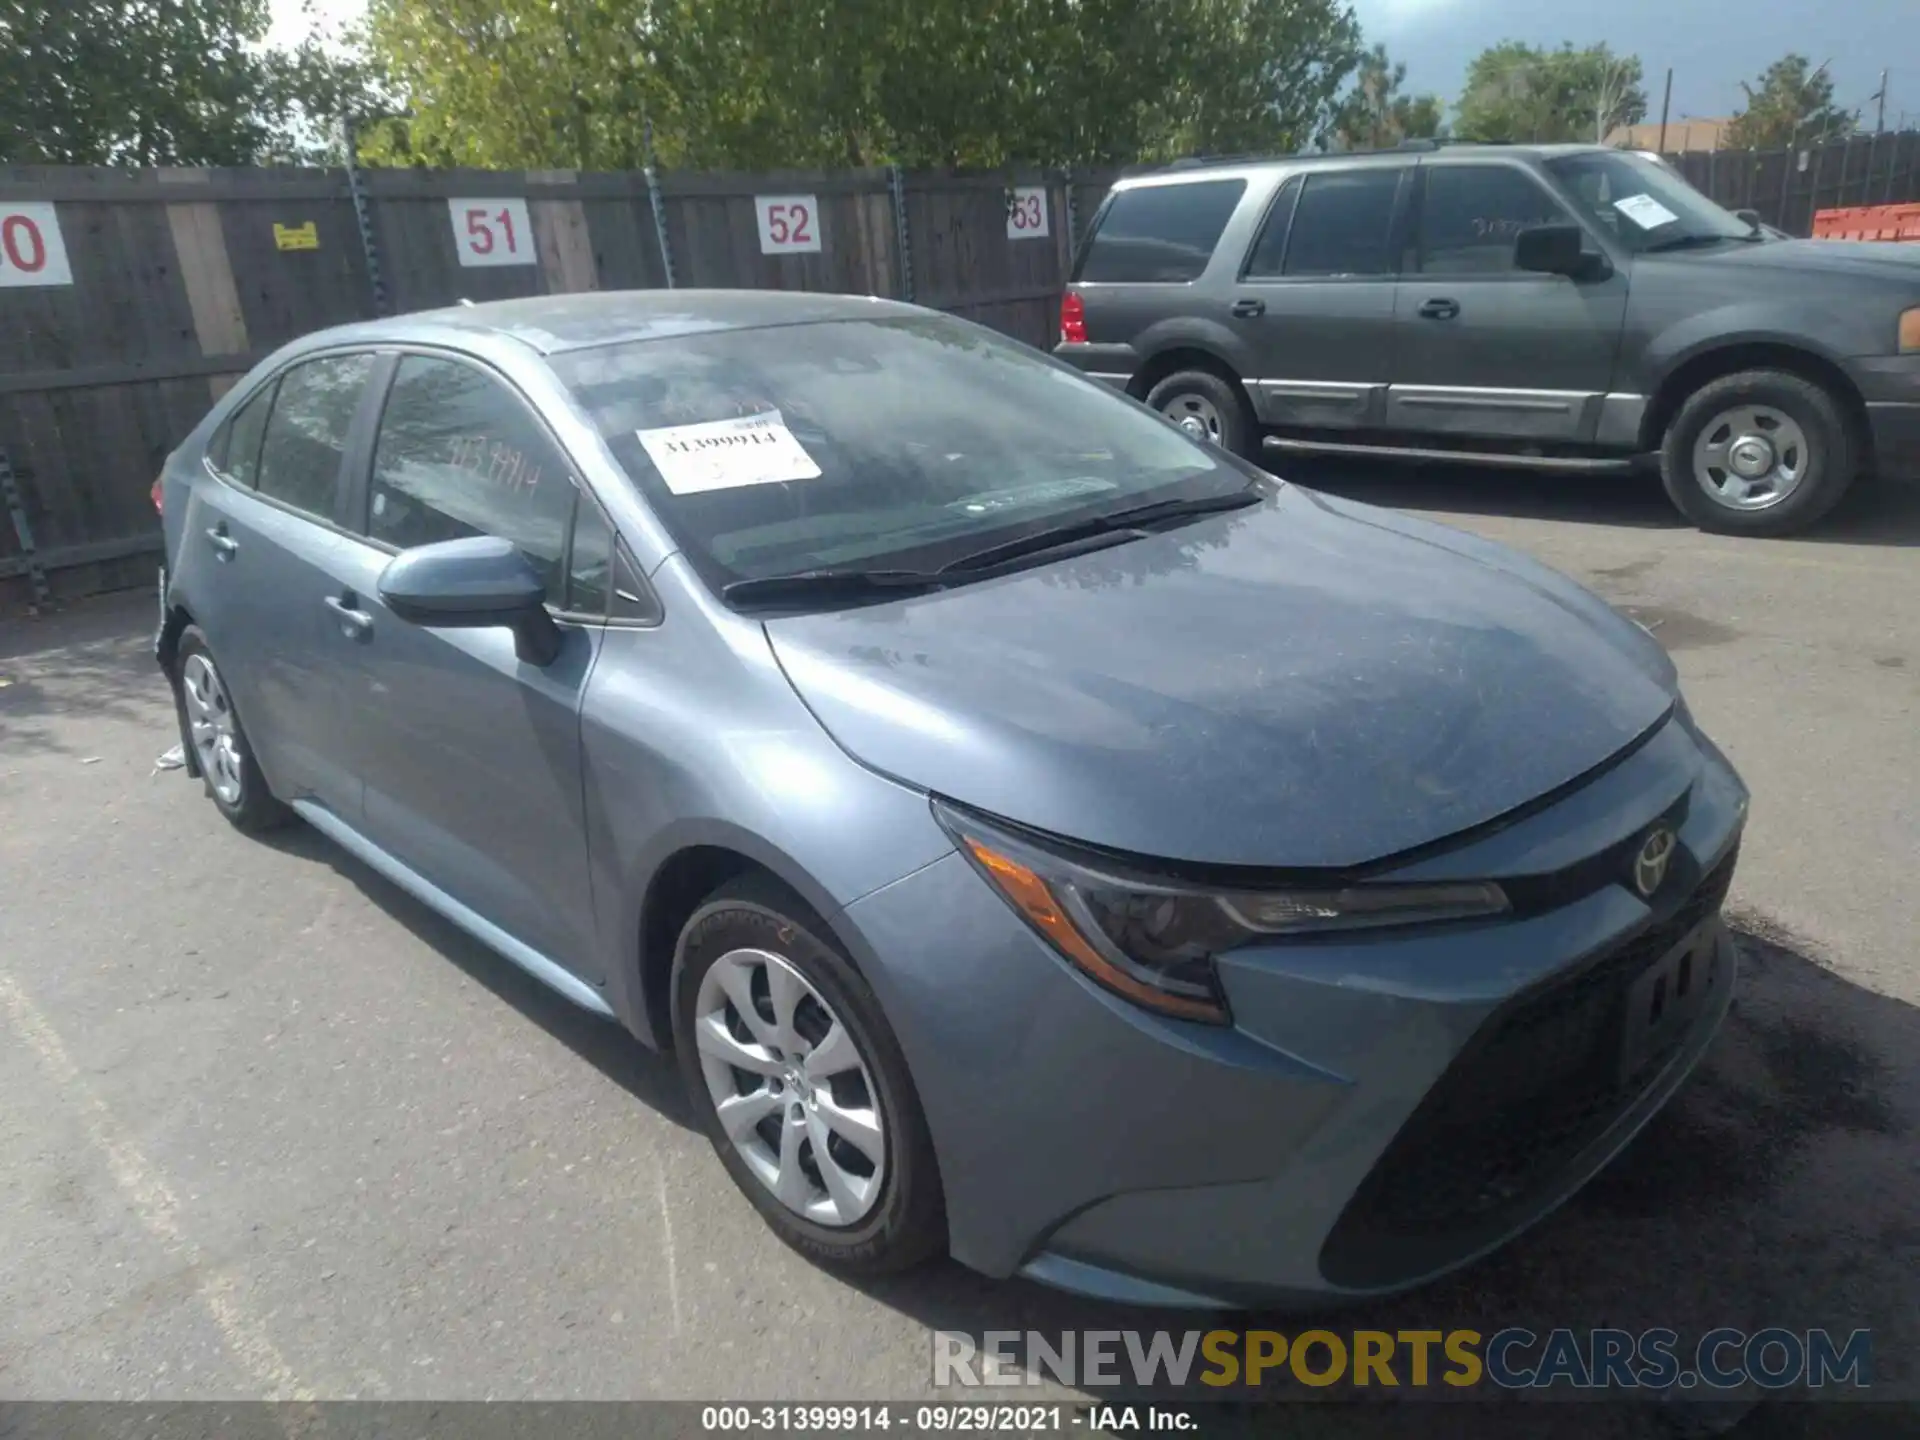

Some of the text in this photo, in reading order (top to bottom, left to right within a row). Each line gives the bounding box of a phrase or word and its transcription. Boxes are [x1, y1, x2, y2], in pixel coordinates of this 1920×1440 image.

[466, 207, 518, 255] 51
[767, 204, 812, 245] 52
[1012, 195, 1041, 230] 53
[0, 215, 46, 273] 0
